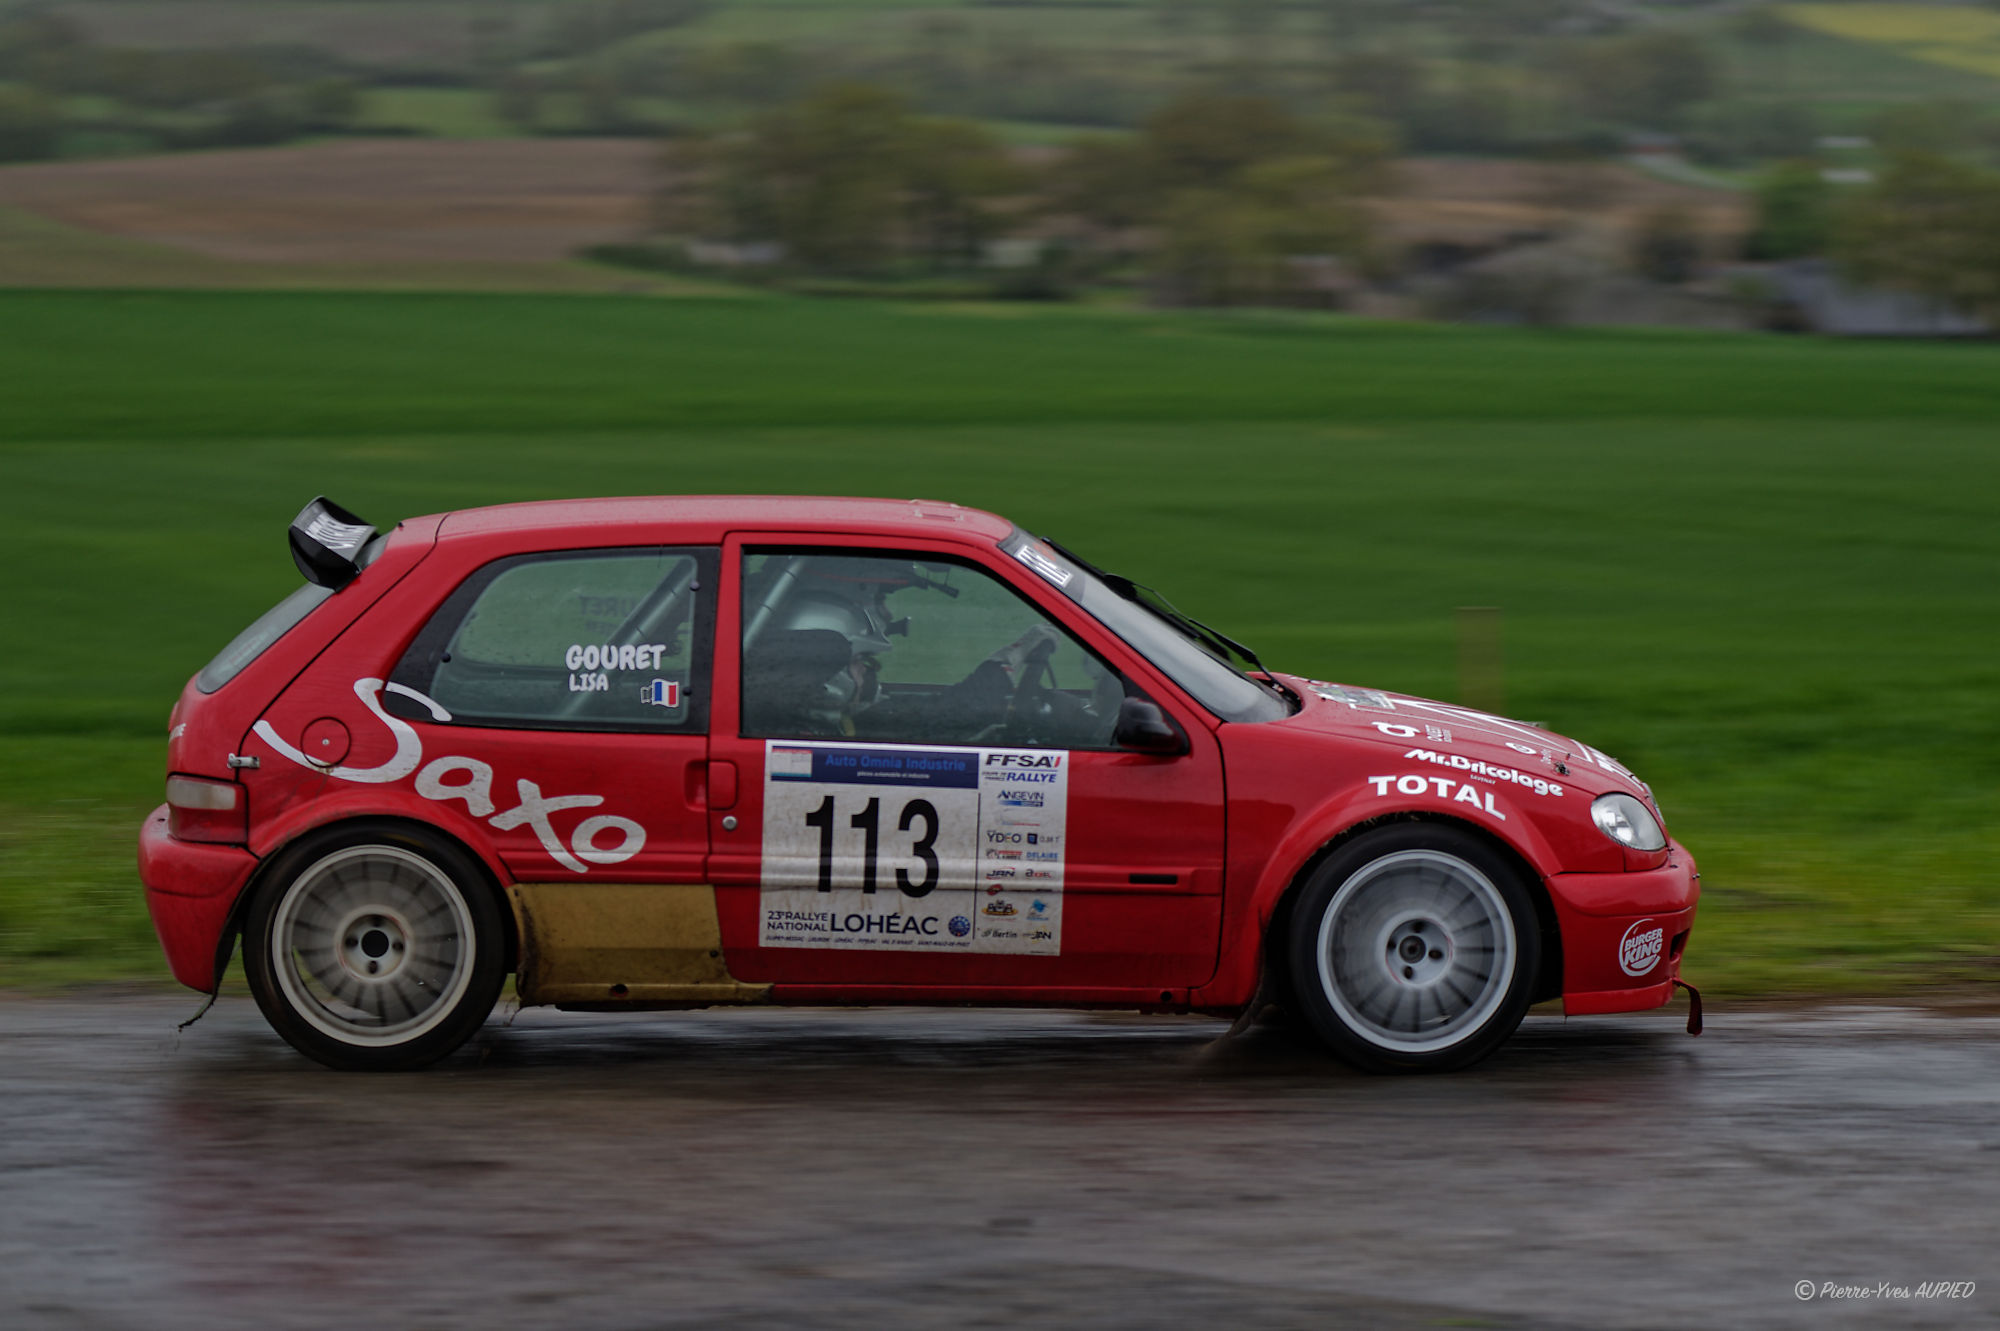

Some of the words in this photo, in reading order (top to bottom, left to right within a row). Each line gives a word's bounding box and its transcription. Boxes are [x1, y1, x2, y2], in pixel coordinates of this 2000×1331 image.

[565, 644, 667, 671] GOURET
[569, 673, 609, 691] LISA
[825, 754, 857, 767] Auto
[860, 755, 903, 769] Omnia
[906, 757, 966, 771] Industrie
[985, 754, 1052, 768] FFSA
[1404, 748, 1564, 797] Mr.Bricolage
[253, 677, 646, 874] Saxo
[1006, 772, 1057, 783] RALLYE
[997, 790, 1045, 800] ANGEVIN
[1368, 775, 1506, 821] TOTAL
[805, 795, 940, 898] 113
[767, 922, 828, 932] NATIONAL
[785, 911, 828, 921] RALLYE
[831, 912, 939, 935] LOHÉAC
[1624, 928, 1663, 952] BURGER
[1624, 938, 1663, 967] KING
